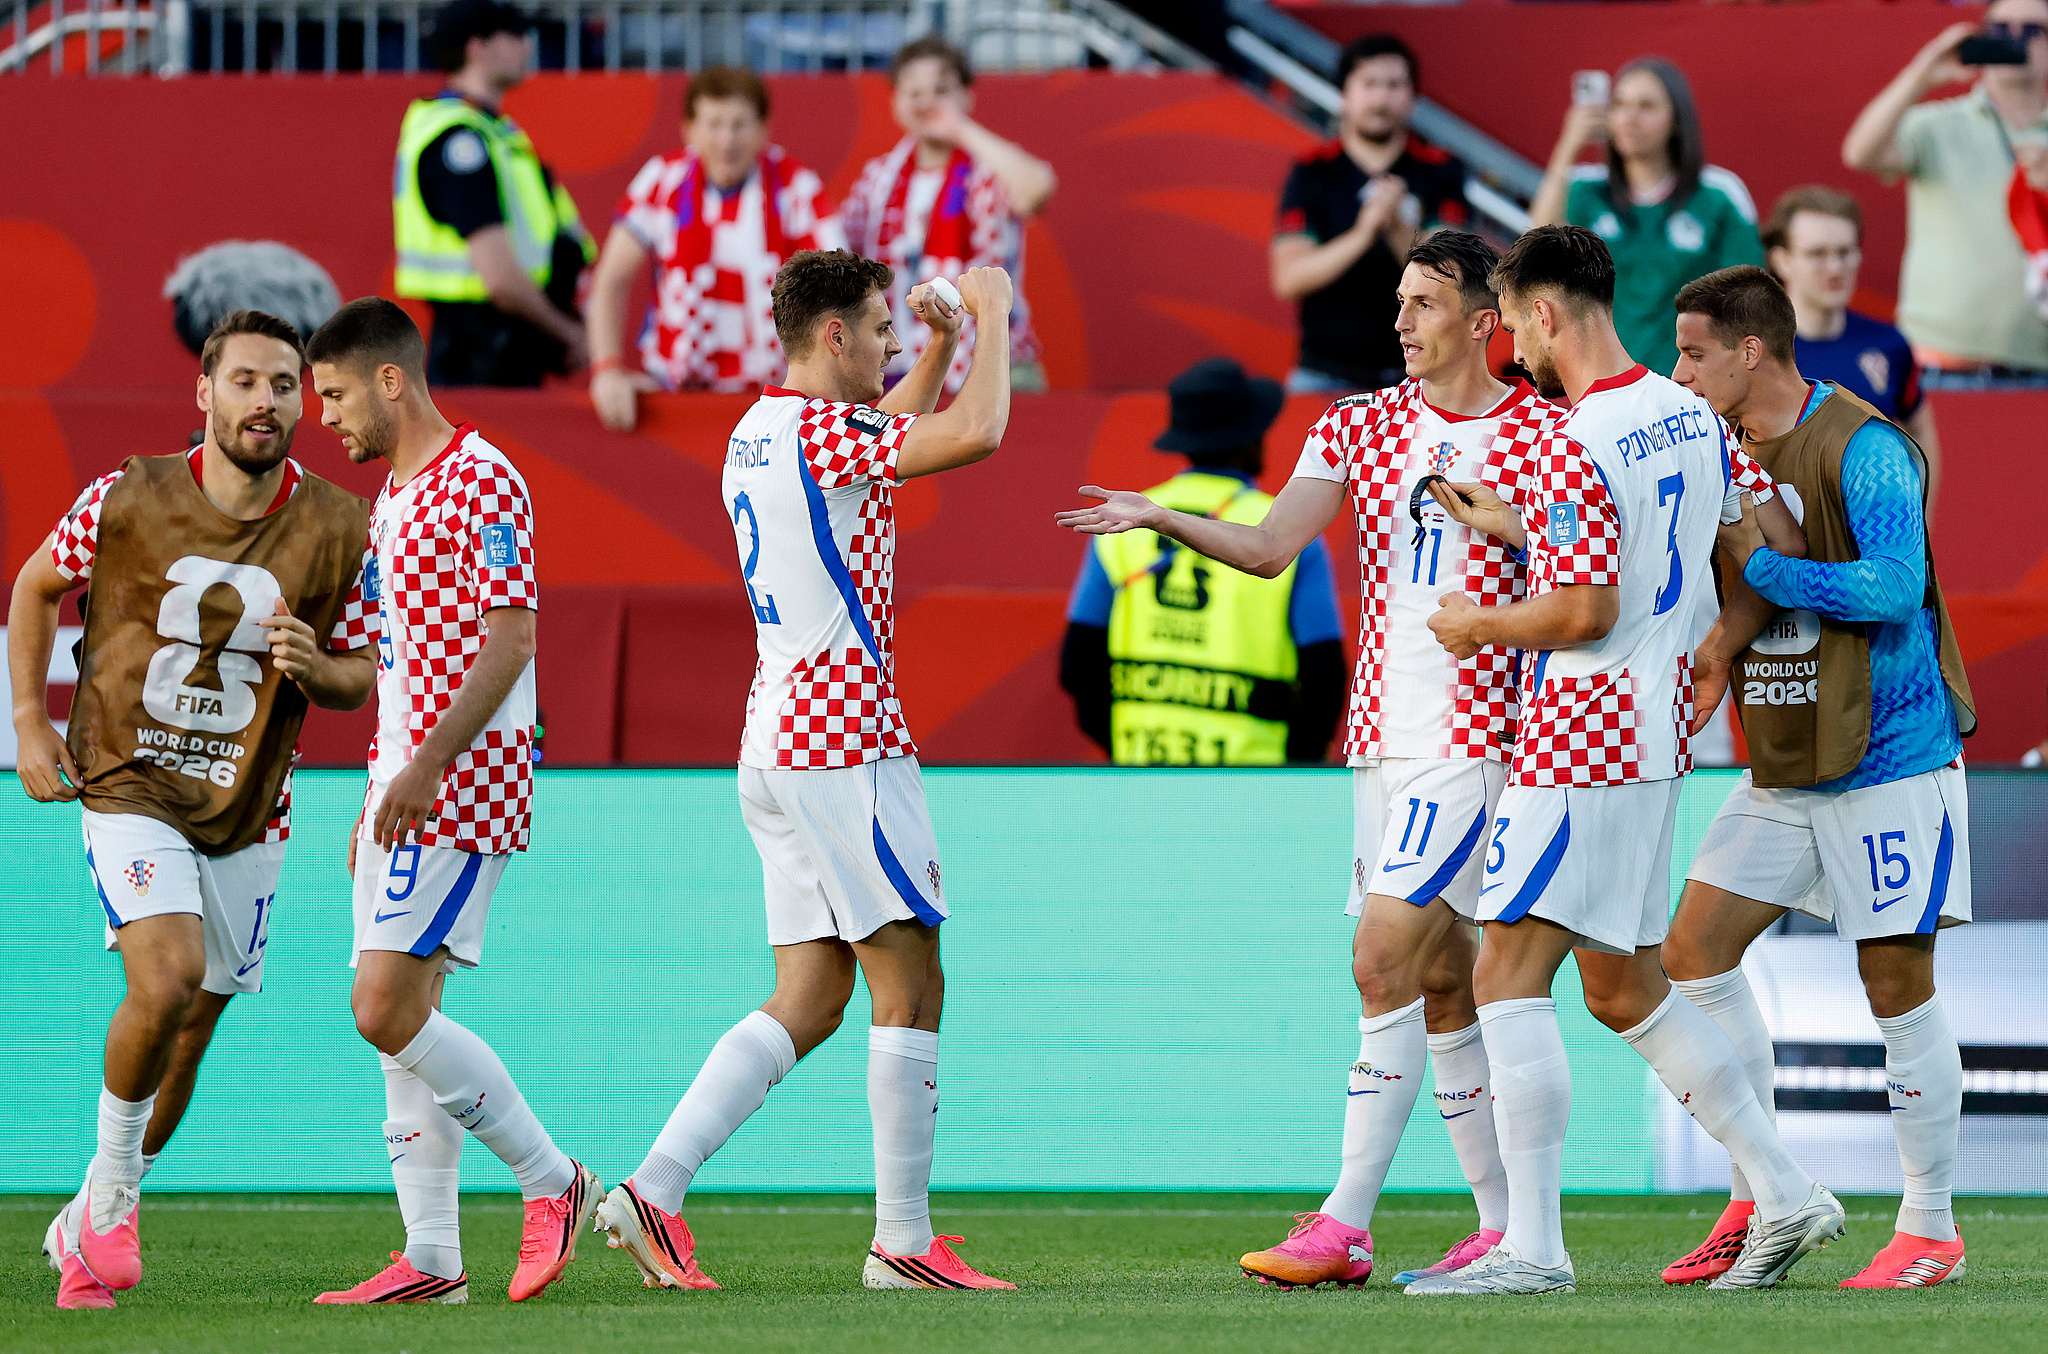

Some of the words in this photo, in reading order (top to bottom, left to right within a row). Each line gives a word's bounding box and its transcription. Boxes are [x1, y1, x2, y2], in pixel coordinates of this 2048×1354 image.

[732, 491, 782, 625] 2
[1411, 526, 1443, 586] 11
[1652, 471, 1685, 615] 3
[1768, 621, 1799, 639] FIFA
[1743, 662, 1794, 678] WORLD
[1795, 660, 1819, 677] CU
[175, 693, 224, 717] FIFA
[136, 727, 204, 752] WORLD
[206, 740, 245, 760] CUP
[1398, 797, 1439, 857] 11
[1486, 817, 1511, 874] 3
[386, 844, 423, 902] 9
[1862, 830, 1911, 892] 15
[1886, 1080, 1905, 1094] NS
[451, 1106, 475, 1119] NS
[385, 1134, 403, 1144] NS
